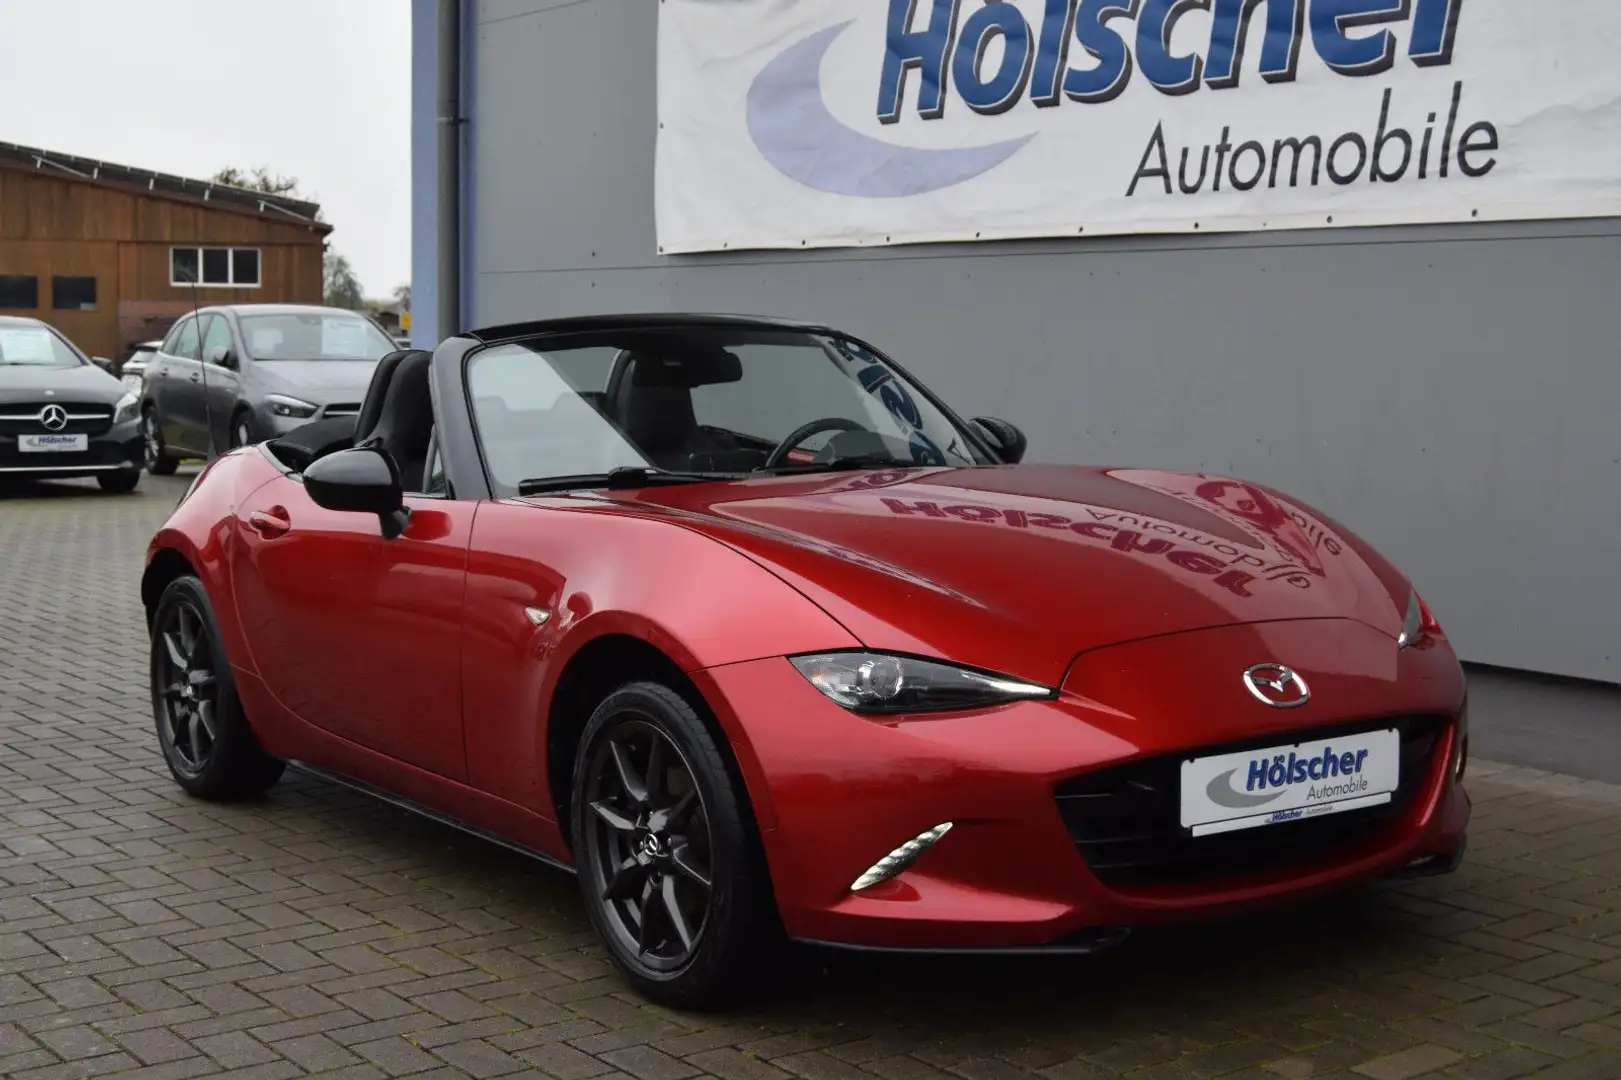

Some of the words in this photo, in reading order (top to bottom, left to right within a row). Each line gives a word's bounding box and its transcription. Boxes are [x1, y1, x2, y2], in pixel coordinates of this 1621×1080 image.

[1125, 81, 1498, 196] Automobile
[1246, 747, 1368, 791] Hölscher
[1306, 774, 1368, 800] Automobile
[1273, 809, 1304, 821] Hölscher
